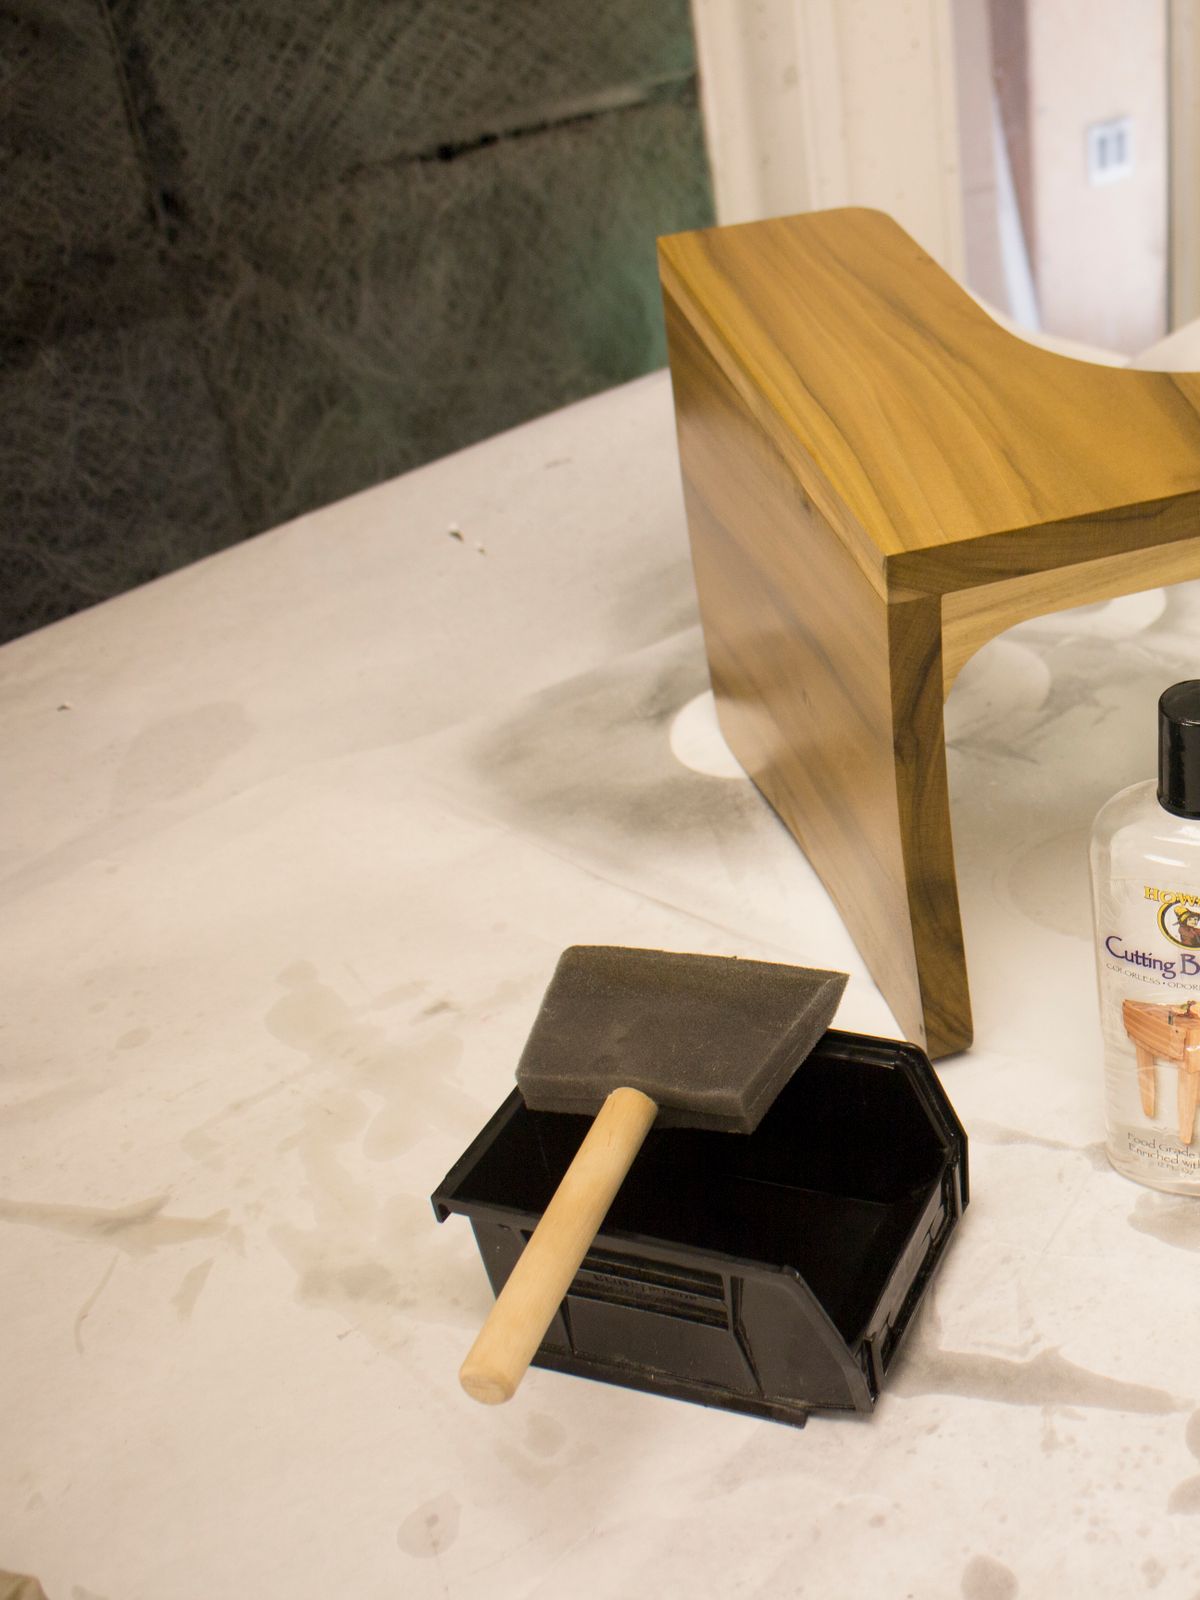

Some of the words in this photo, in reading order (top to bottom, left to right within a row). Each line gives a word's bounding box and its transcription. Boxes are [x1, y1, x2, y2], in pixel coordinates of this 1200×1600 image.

[1105, 935, 1177, 980] Cutting
[1127, 1132, 1156, 1149] Food
[1158, 1144, 1196, 1157] Grade
[1128, 1142, 1179, 1165] Enriched
